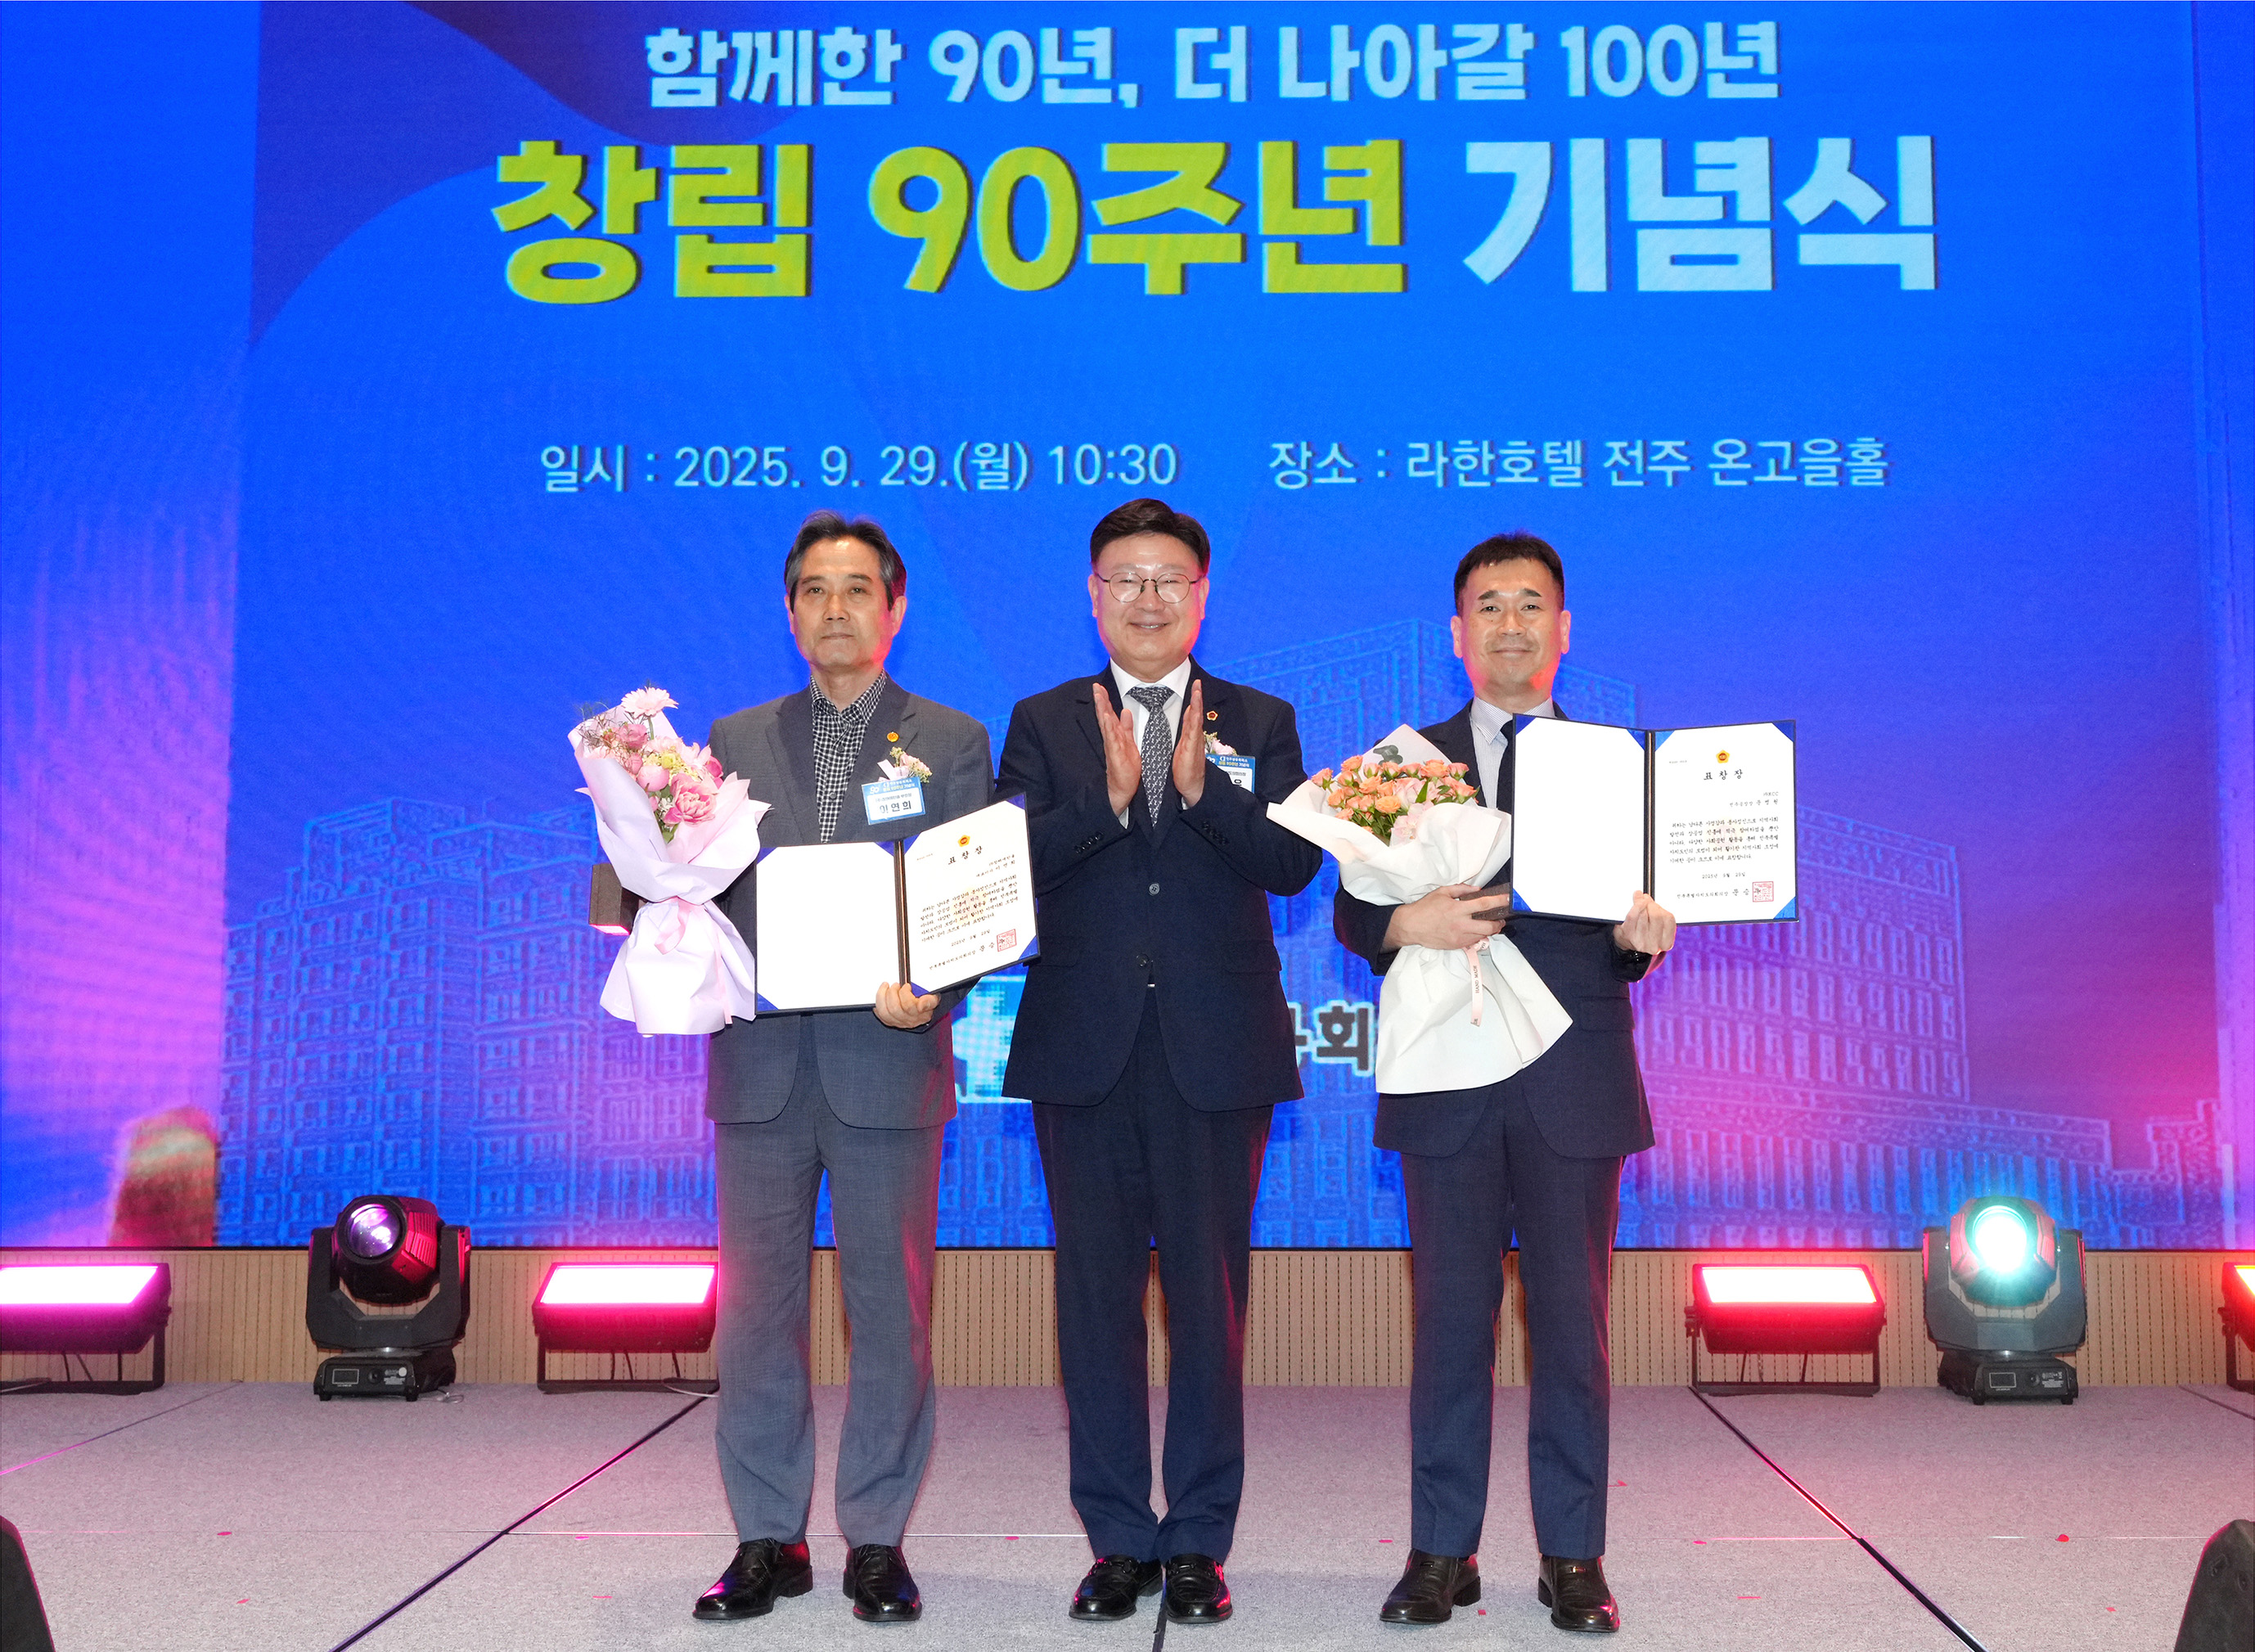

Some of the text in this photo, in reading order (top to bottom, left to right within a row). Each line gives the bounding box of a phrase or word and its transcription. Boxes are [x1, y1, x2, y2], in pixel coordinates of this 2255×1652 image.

[646, 21, 1777, 108] 함께한 90년, 더 나아갈 100년
[496, 136, 1934, 304] 창립 90주년 기념식
[542, 445, 623, 492] 일시
[675, 446, 799, 487] 2025.
[821, 446, 858, 487] 9.
[880, 442, 1027, 491] 29.(월)
[1049, 443, 1175, 484] 10:30
[1270, 441, 1356, 489] 장소
[1408, 440, 1582, 488] 라한호텔
[1604, 440, 1690, 487] 전주
[1708, 438, 1887, 486] 온고을홀
